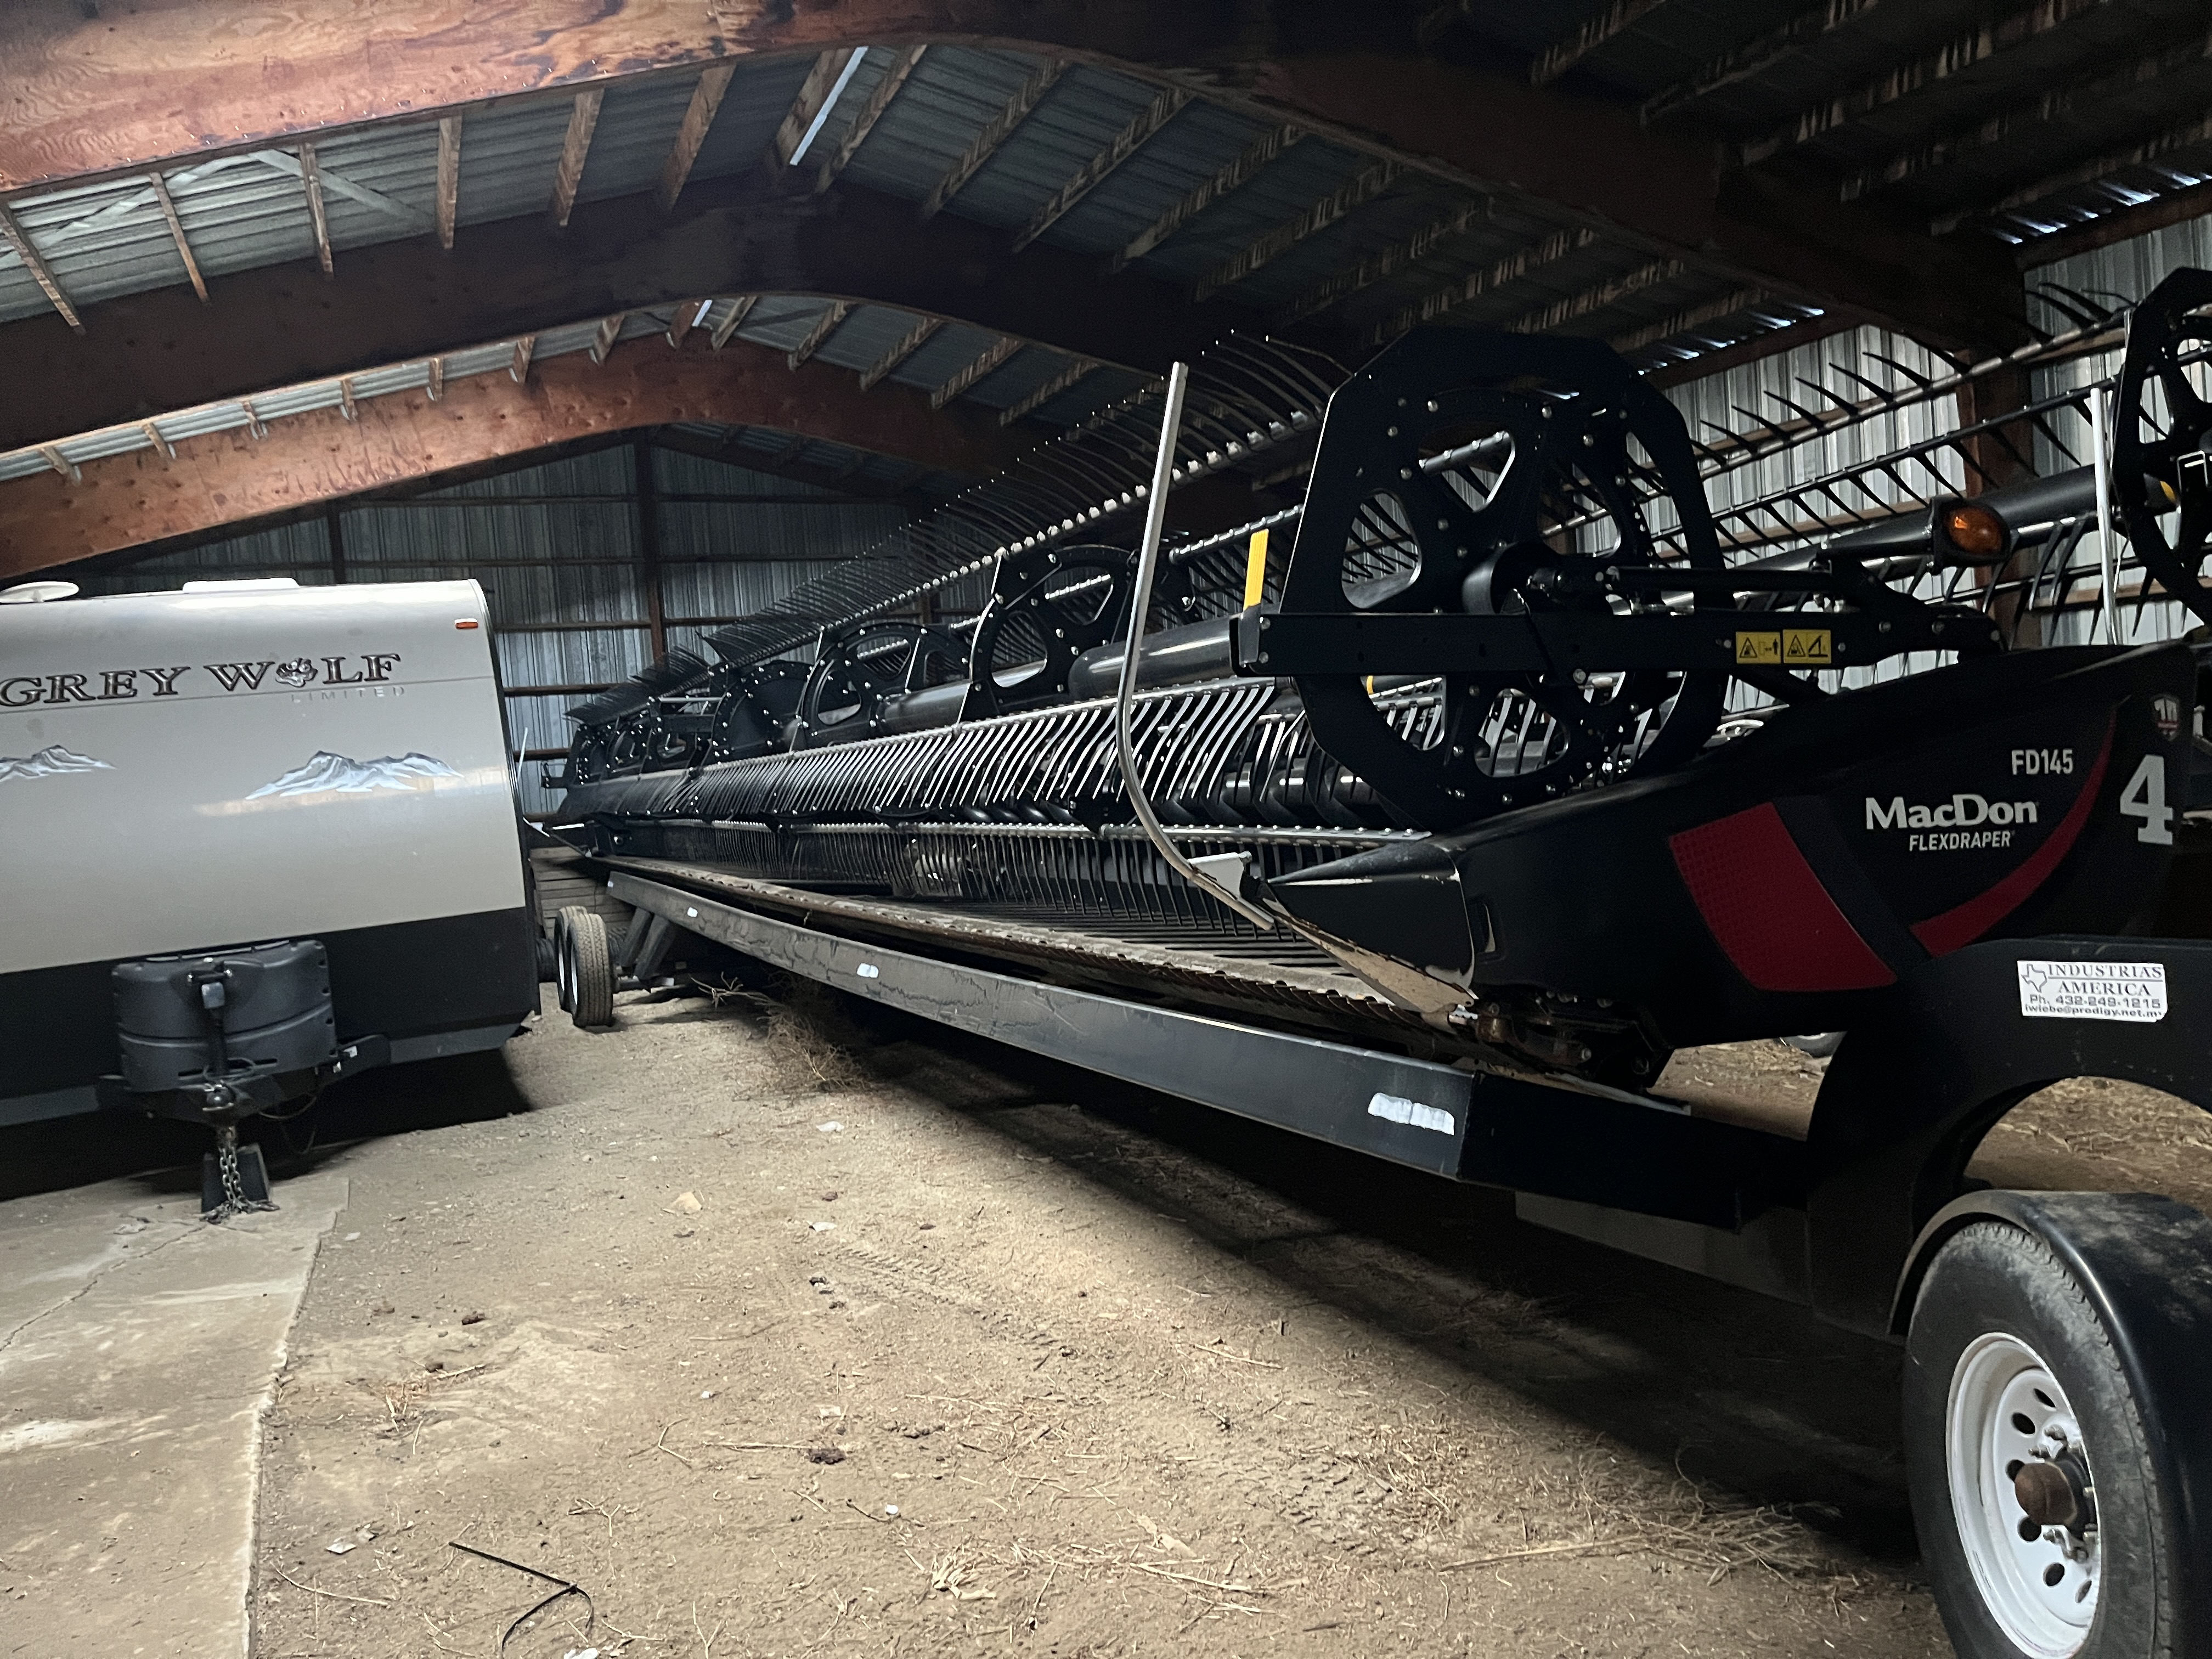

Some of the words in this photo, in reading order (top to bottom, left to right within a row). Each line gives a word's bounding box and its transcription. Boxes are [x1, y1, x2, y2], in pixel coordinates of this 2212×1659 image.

[0, 666, 191, 707] GREY
[291, 686, 404, 703] LIMITED
[2011, 748, 2073, 775] FD145
[2120, 754, 2173, 845] 4
[1865, 793, 2037, 830] MacDon
[1909, 831, 2010, 851] FLEXDRAPER
[2048, 964, 2162, 978] INDUSTRIAS
[2058, 981, 2152, 996] AMERICA
